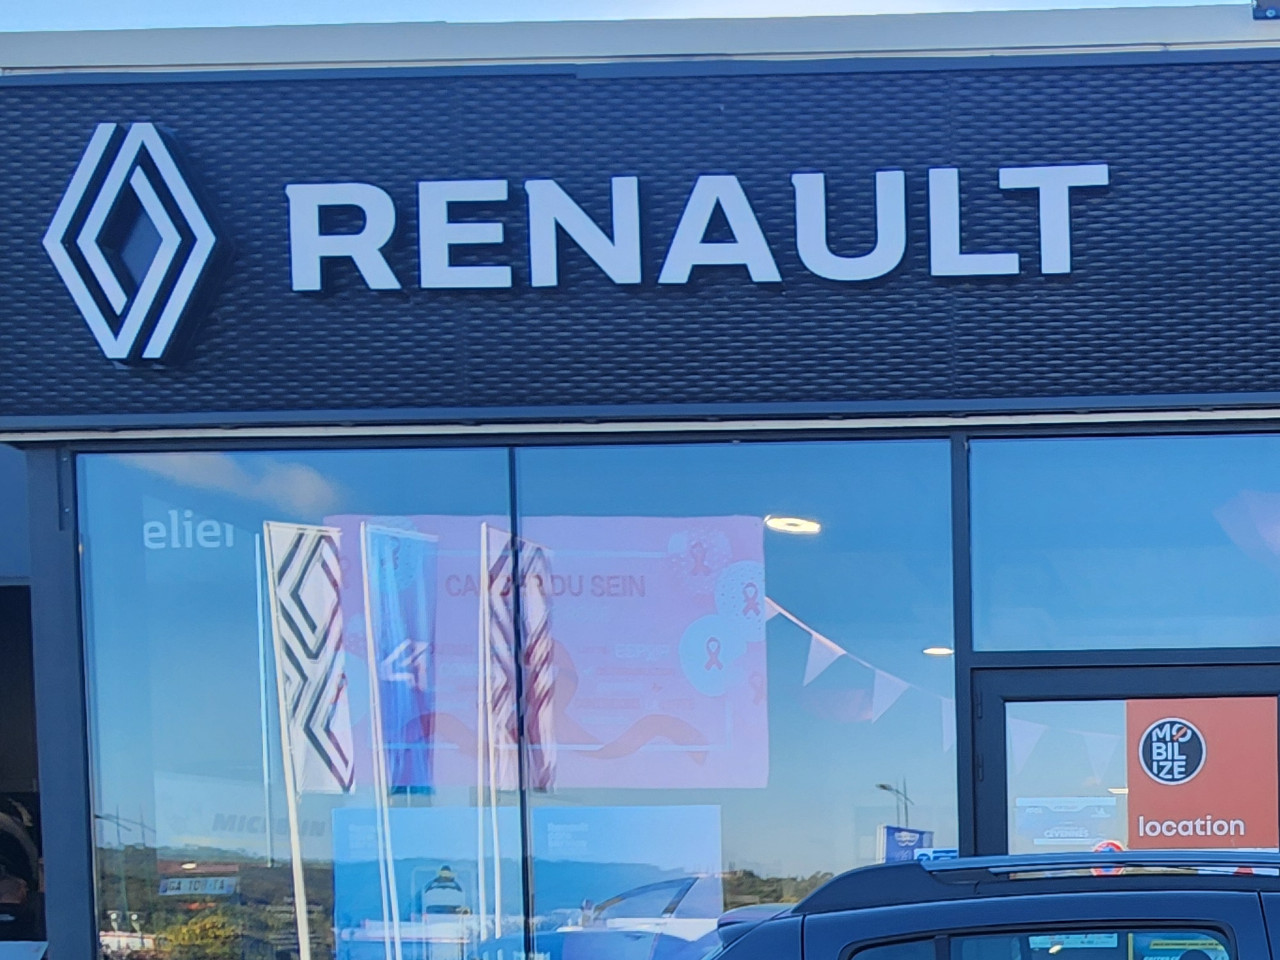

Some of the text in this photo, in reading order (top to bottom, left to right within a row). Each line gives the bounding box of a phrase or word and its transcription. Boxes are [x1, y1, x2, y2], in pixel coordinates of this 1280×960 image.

[284, 163, 1110, 292] RENAULT
[551, 574, 584, 597] DU
[590, 575, 646, 598] SEIN
[1138, 814, 1245, 837] location
